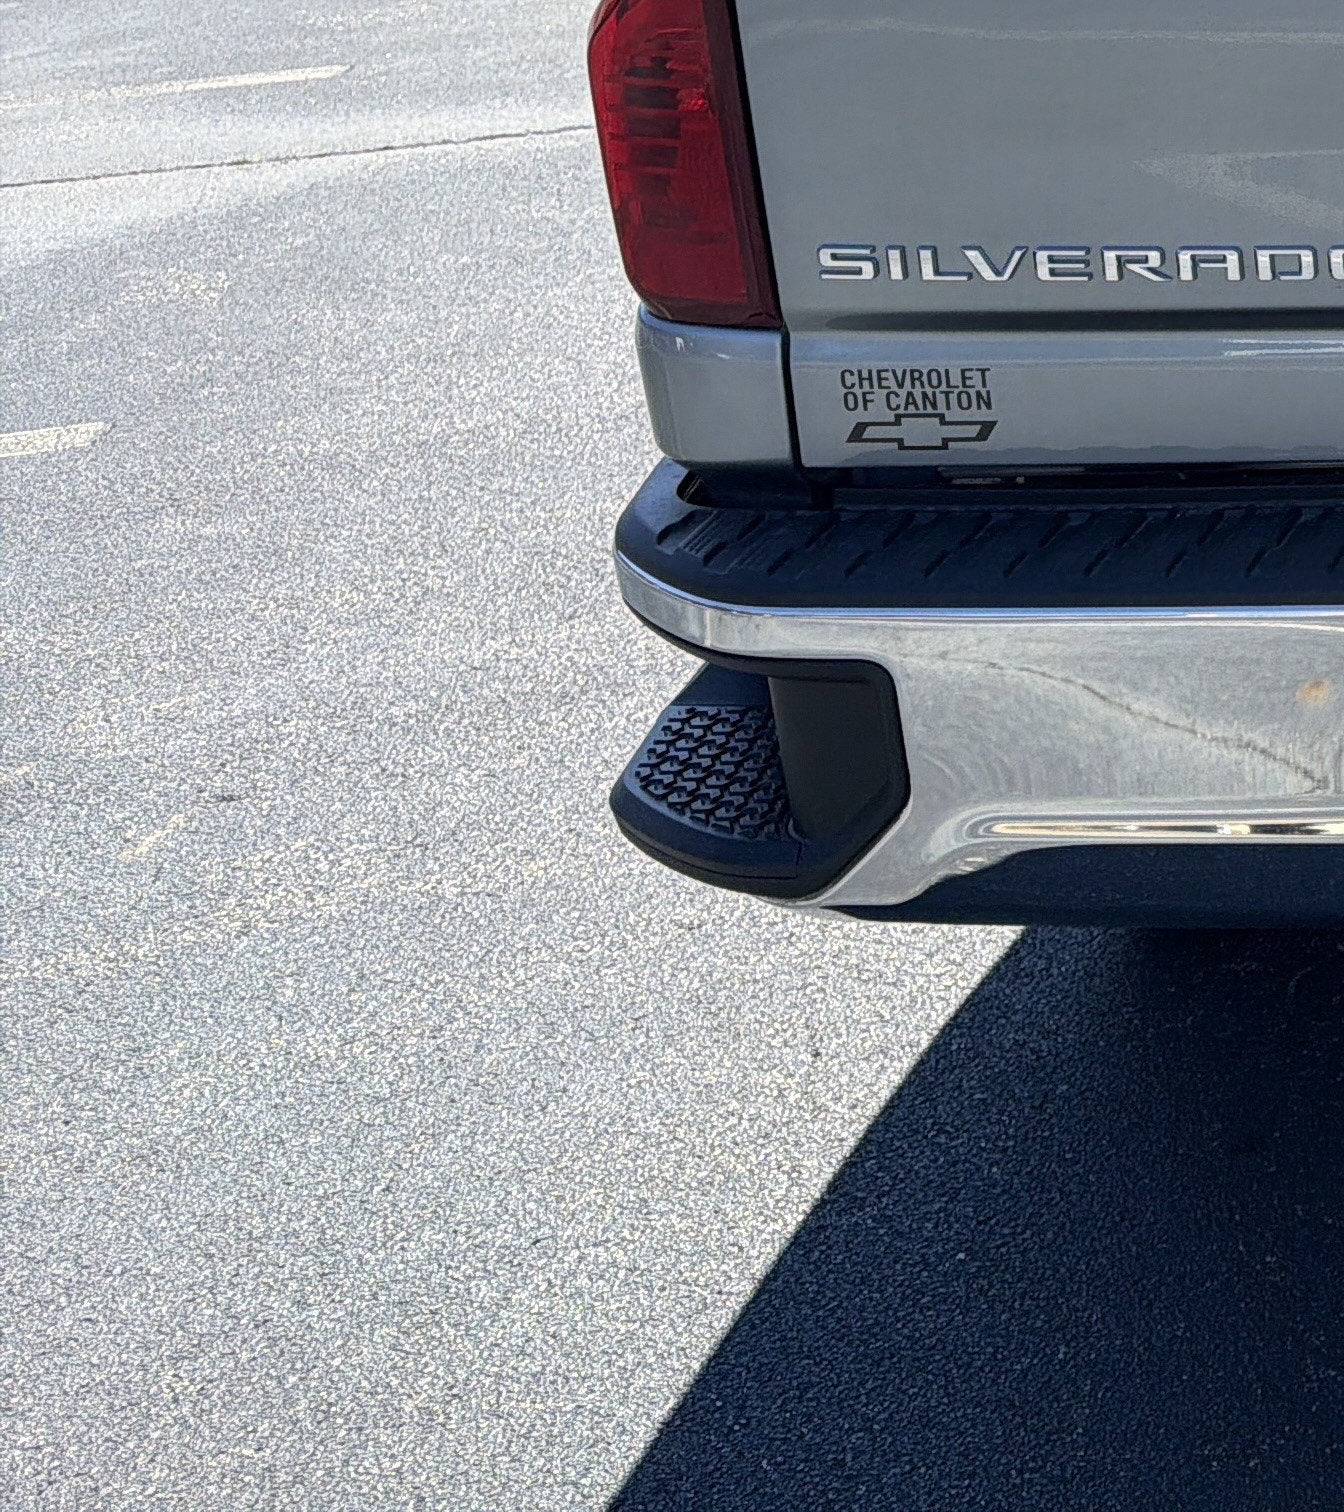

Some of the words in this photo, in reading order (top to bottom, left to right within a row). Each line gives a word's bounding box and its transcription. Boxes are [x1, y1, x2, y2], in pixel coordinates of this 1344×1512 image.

[840, 367, 991, 390] CHEVROLET
[843, 390, 875, 411] OF
[885, 390, 992, 411] CANTON
